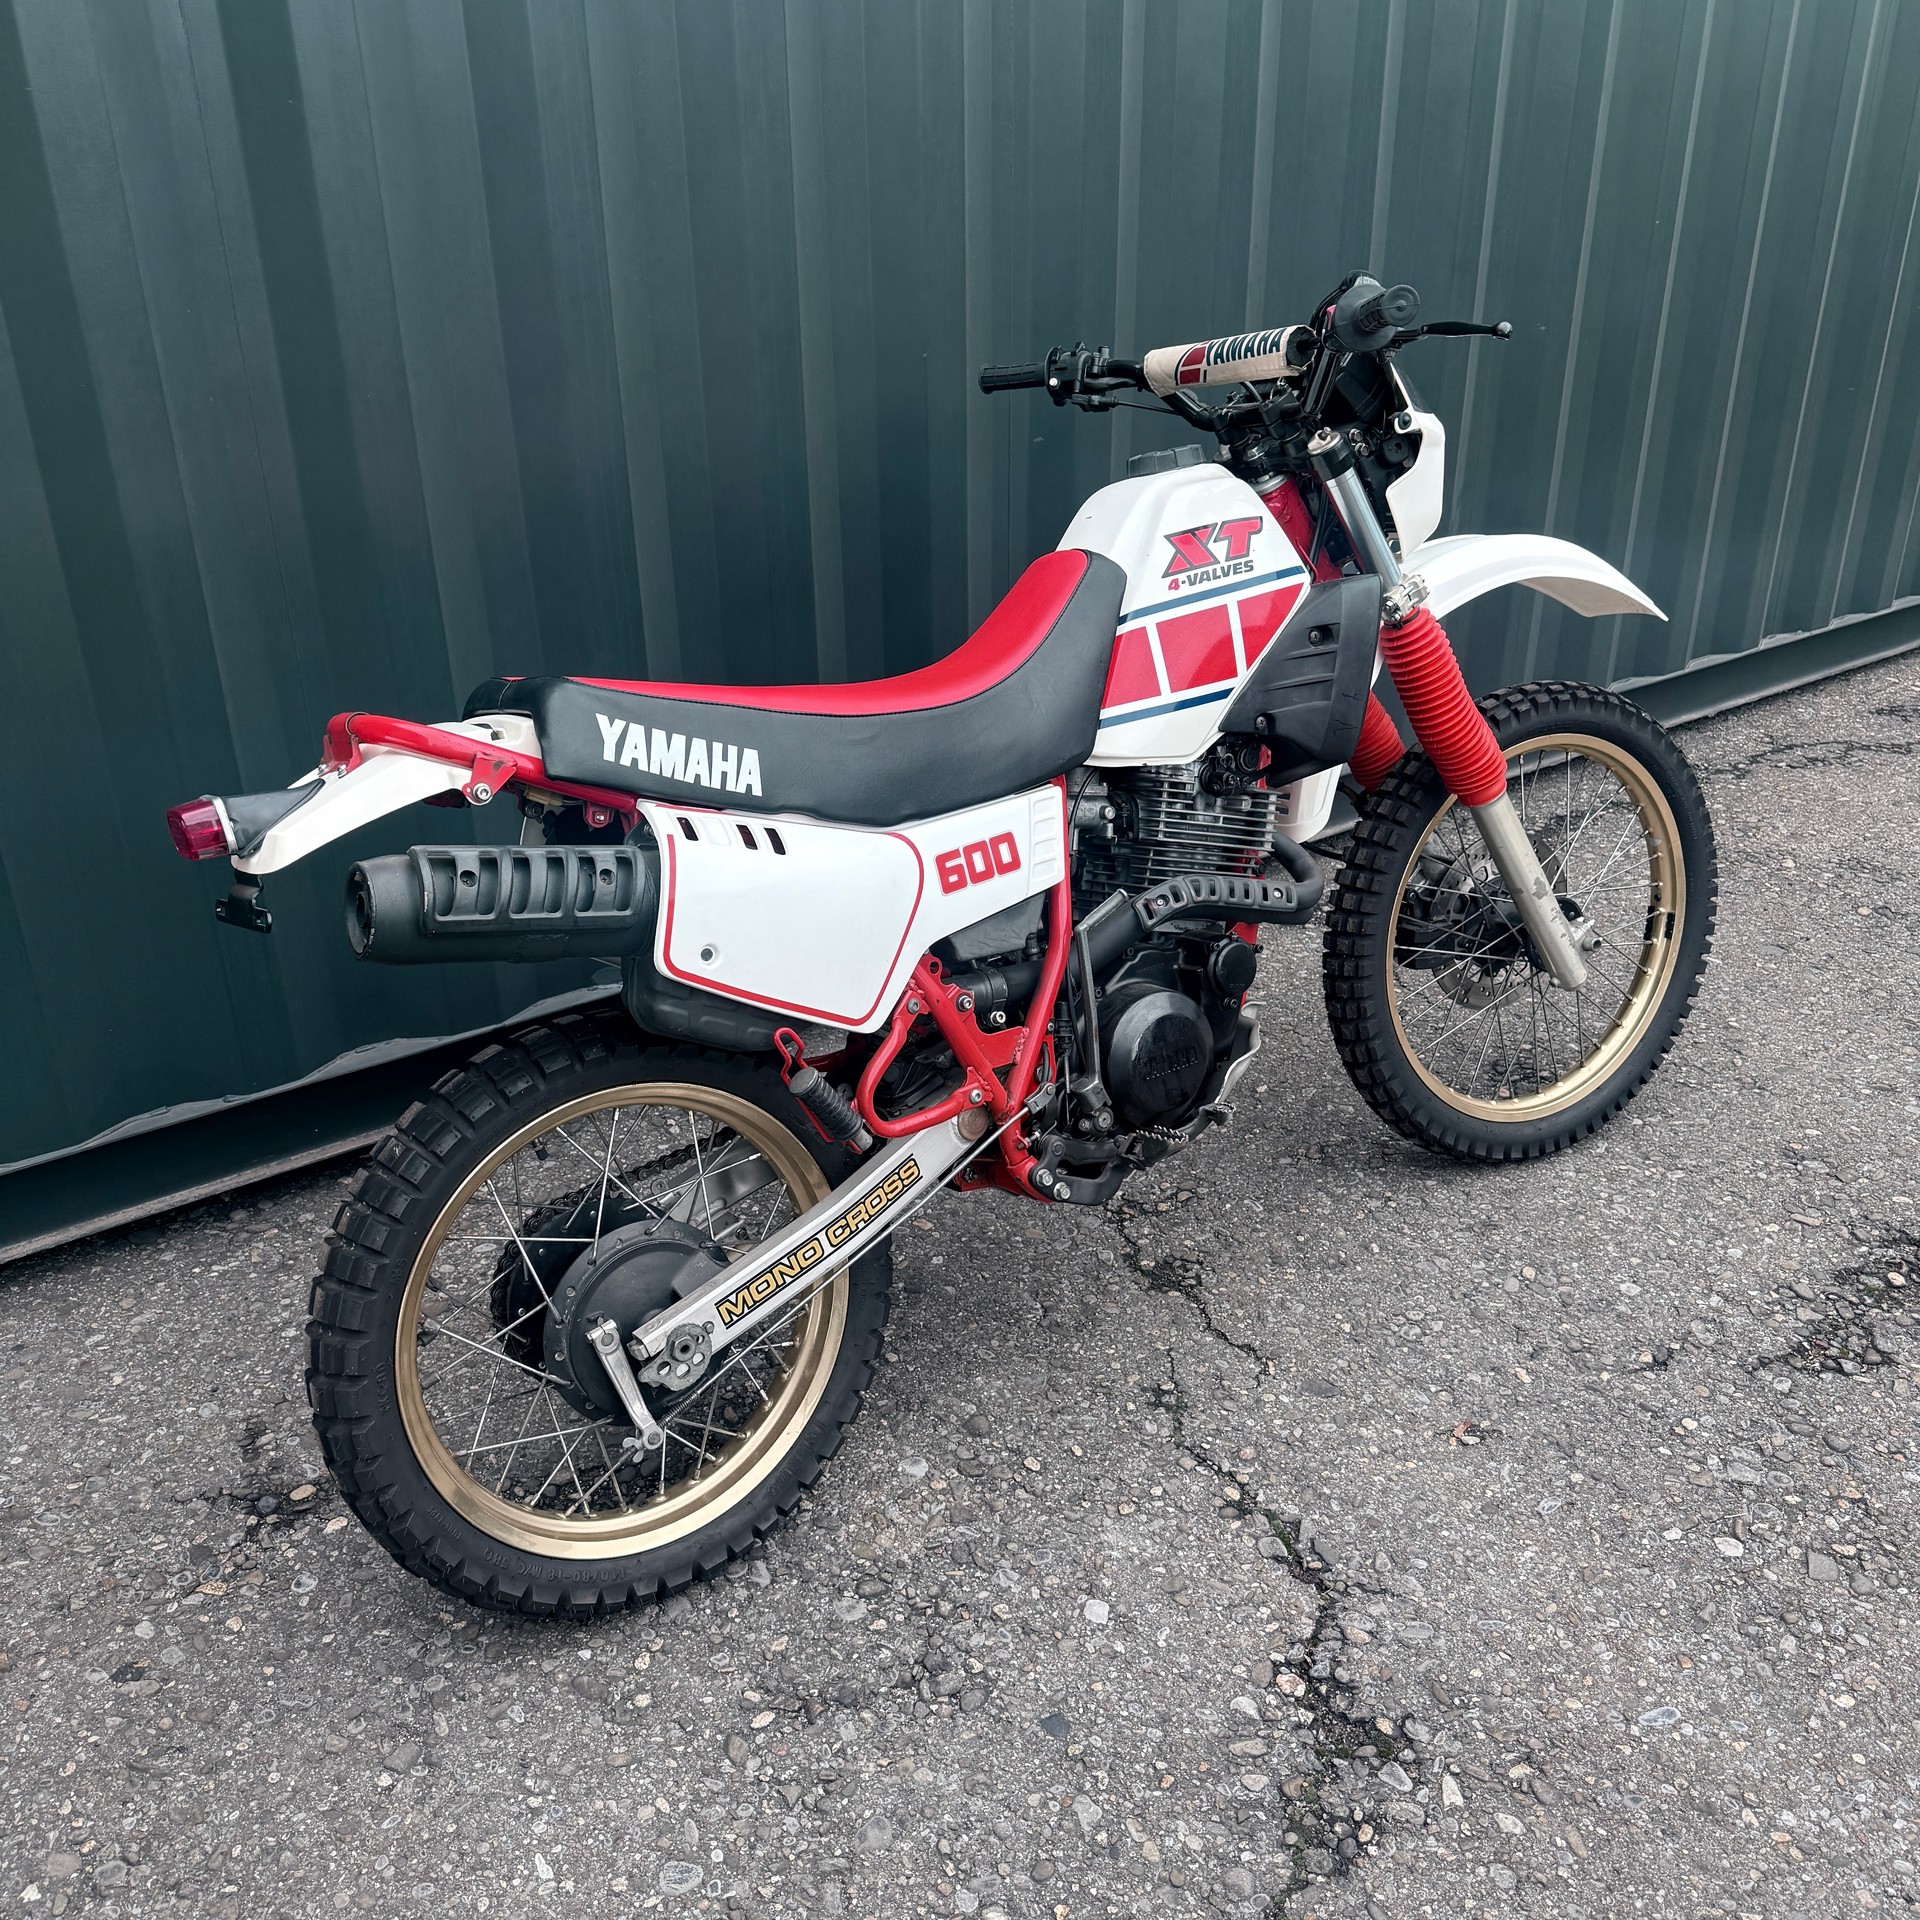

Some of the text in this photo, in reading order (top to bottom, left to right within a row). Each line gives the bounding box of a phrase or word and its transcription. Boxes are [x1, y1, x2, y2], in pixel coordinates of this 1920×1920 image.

[1206, 328, 1288, 366] YAMAHA
[1161, 515, 1264, 579] XT
[1167, 559, 1255, 591] 4-VALVES
[595, 712, 763, 797] YAMAHA
[934, 830, 1022, 896] 600
[716, 1237, 824, 1326] MONO
[825, 1157, 921, 1249] CROSS
